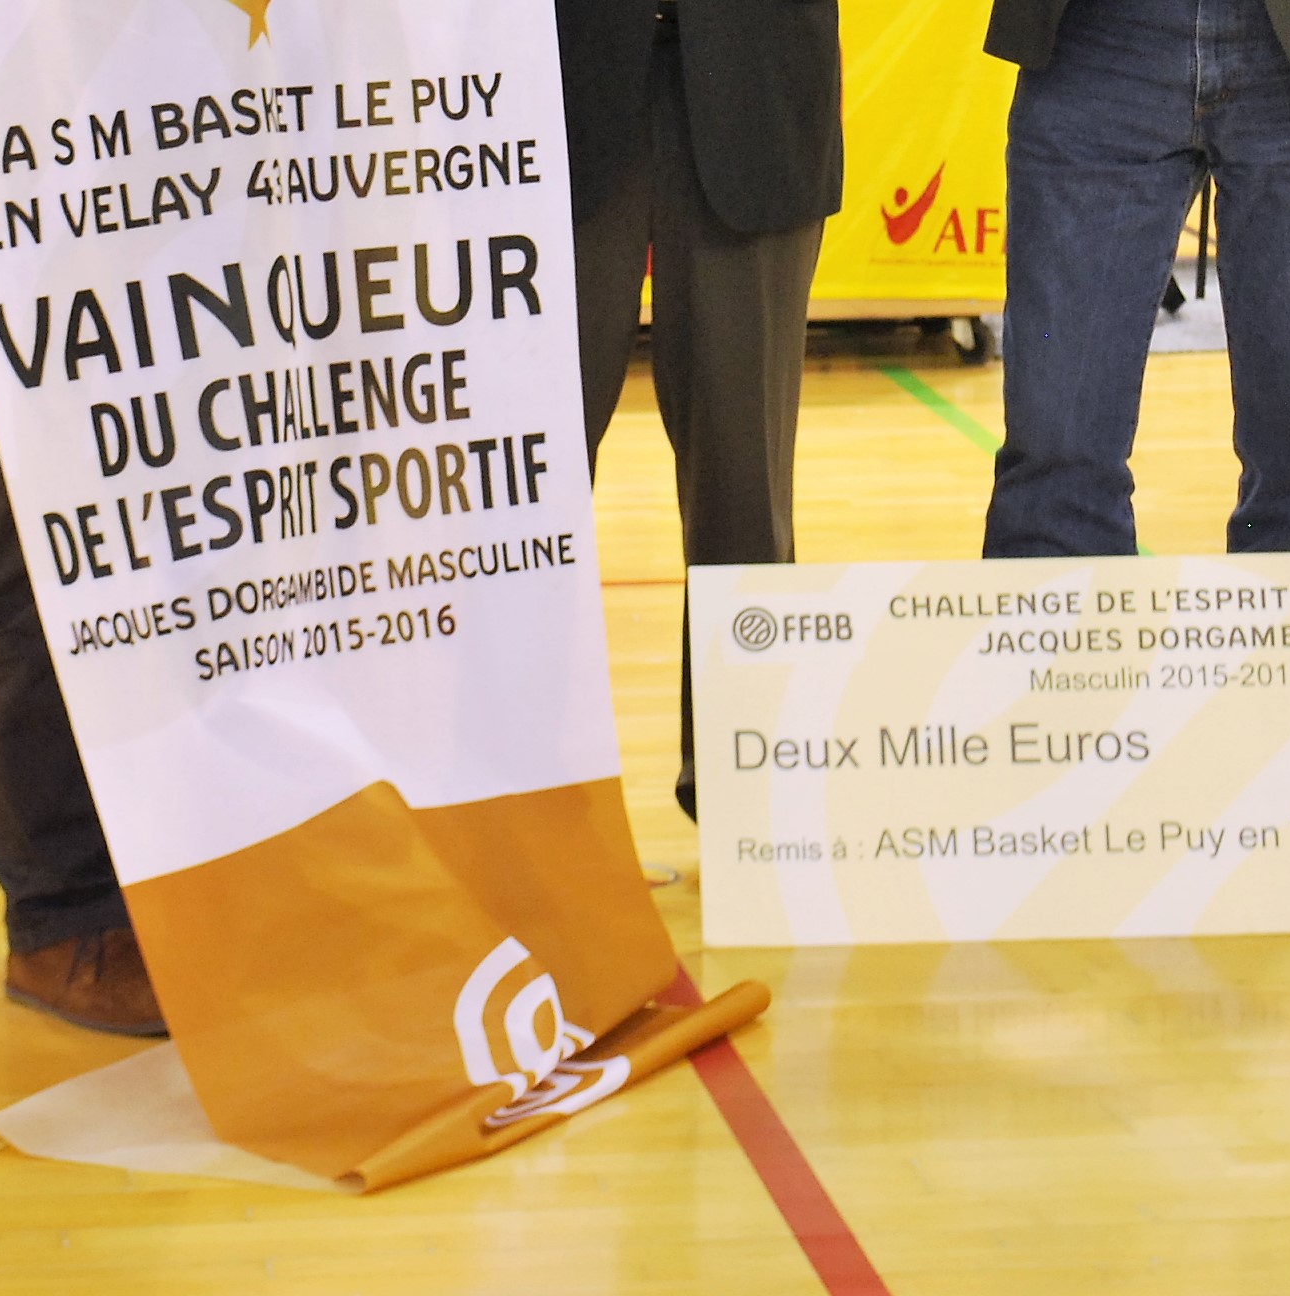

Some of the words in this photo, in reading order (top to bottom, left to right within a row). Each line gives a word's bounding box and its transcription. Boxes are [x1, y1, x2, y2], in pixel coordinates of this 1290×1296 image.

[150, 85, 314, 151] BASKET
[335, 81, 393, 129] LE
[411, 72, 502, 124] PUY
[59, 166, 221, 238] VELAY
[933, 207, 1007, 255] AF
[90, 392, 177, 477] DU
[198, 349, 471, 452] CHALLENGE
[42, 503, 113, 587] DE
[117, 460, 318, 571] L'ESPRIT
[330, 432, 548, 530] SPORTIF
[69, 597, 197, 656] JACQUES
[208, 561, 377, 621] DORGAMBIDE
[388, 533, 577, 589] MASCULINE
[888, 590, 1083, 620] CHALLENGE
[1096, 590, 1137, 615] DE
[1150, 586, 1289, 614] L'ESPRIT
[195, 632, 295, 681] SAISON
[303, 603, 457, 660] 2015-2016
[782, 612, 854, 643] FFBB
[978, 628, 1122, 655] JACQUES
[1029, 664, 1151, 693] Masculin
[733, 728, 860, 771] Deux
[879, 725, 990, 768] Mille
[1009, 722, 1151, 764] Euros
[737, 837, 823, 863] Remis
[874, 826, 958, 860] ASM
[972, 824, 1093, 857] Basket
[1104, 823, 1145, 854] Le
[1159, 820, 1225, 858] Puy
[1238, 822, 1280, 850] en
